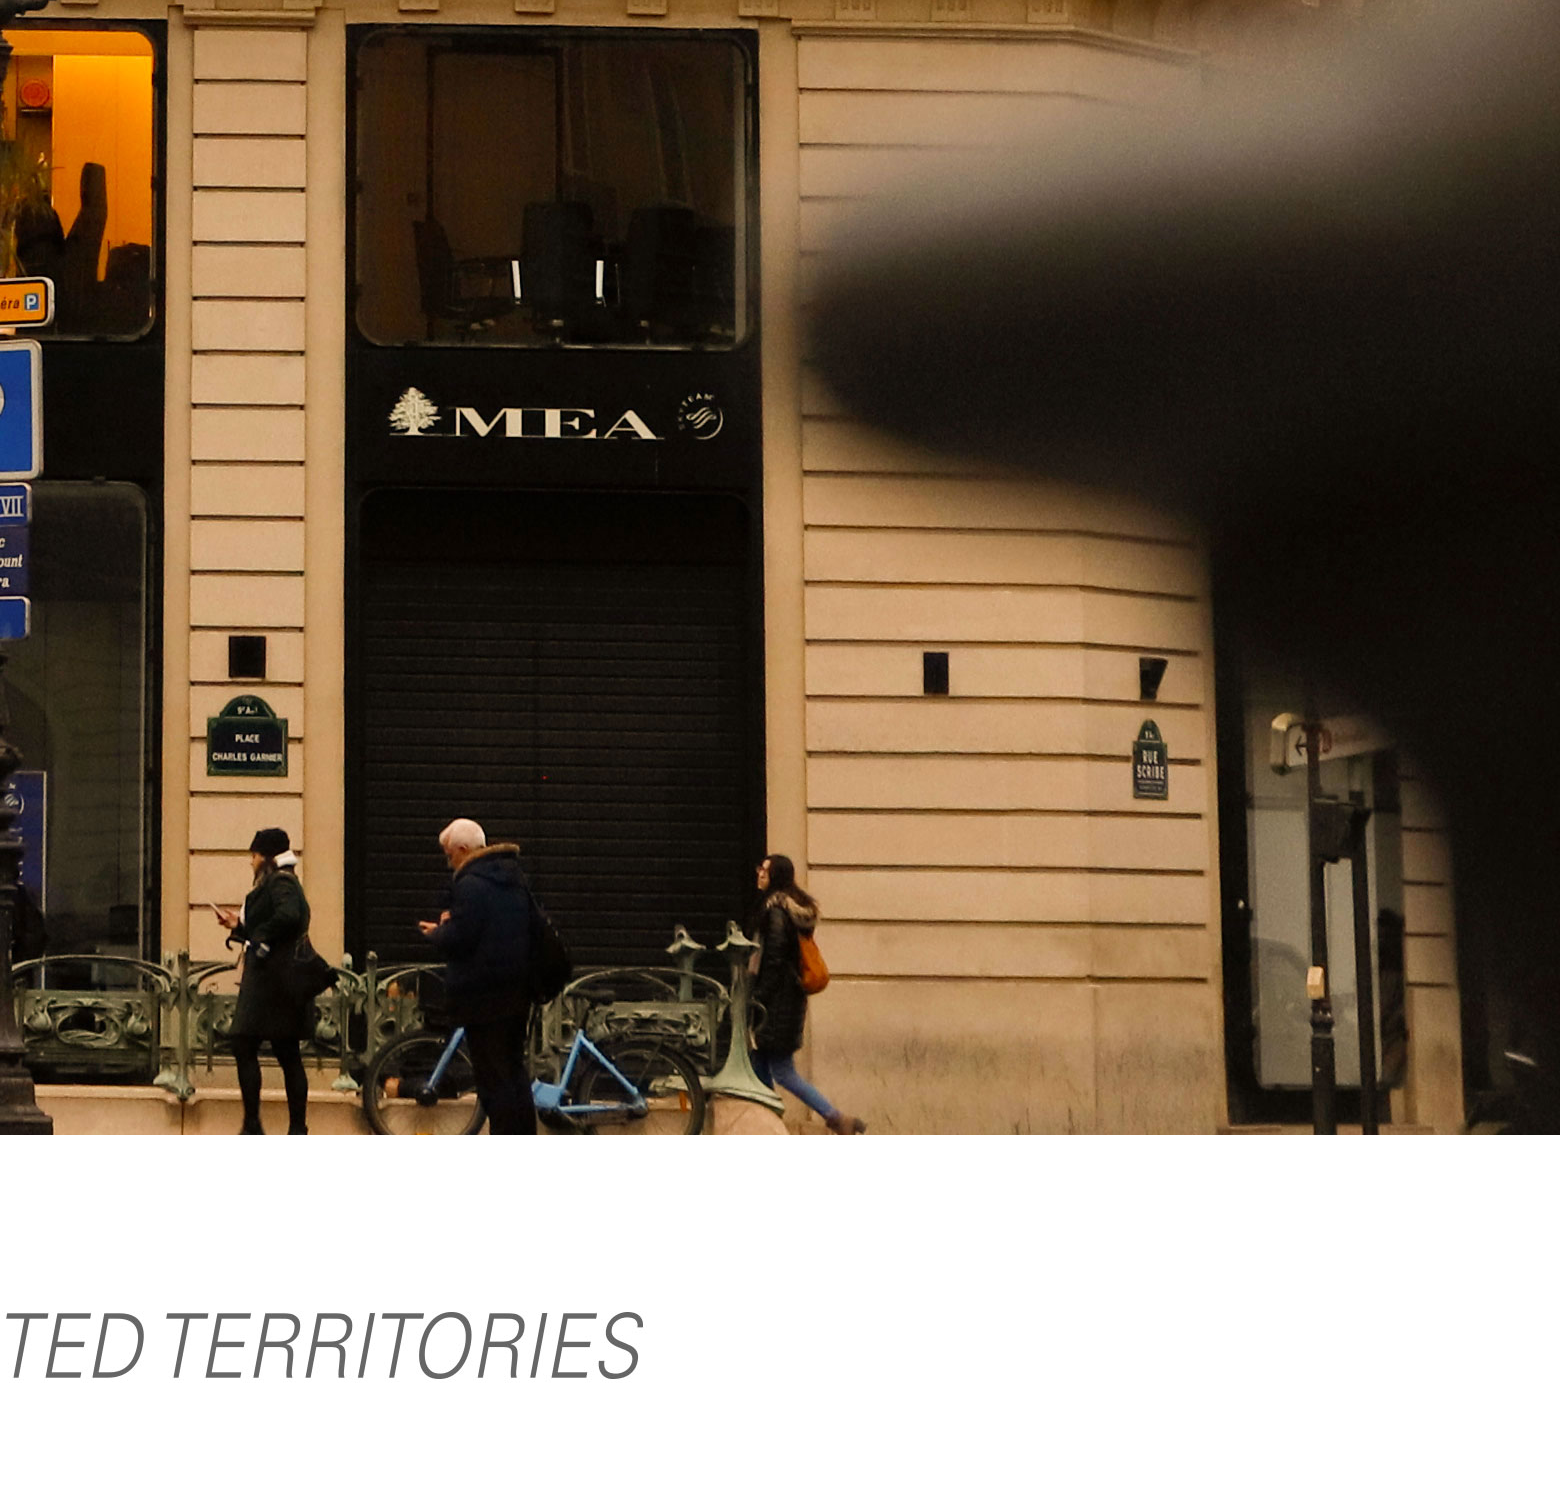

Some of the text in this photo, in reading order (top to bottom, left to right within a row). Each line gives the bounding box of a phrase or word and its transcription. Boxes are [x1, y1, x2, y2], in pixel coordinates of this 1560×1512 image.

[26, 294, 37, 310] P
[447, 406, 665, 440] MEA
[0, 495, 24, 517] VII
[235, 734, 260, 743] PLACE
[212, 752, 283, 762] CHARLES GARNIER
[1142, 750, 1159, 764] RUE
[1137, 765, 1165, 780] SCRIBE
